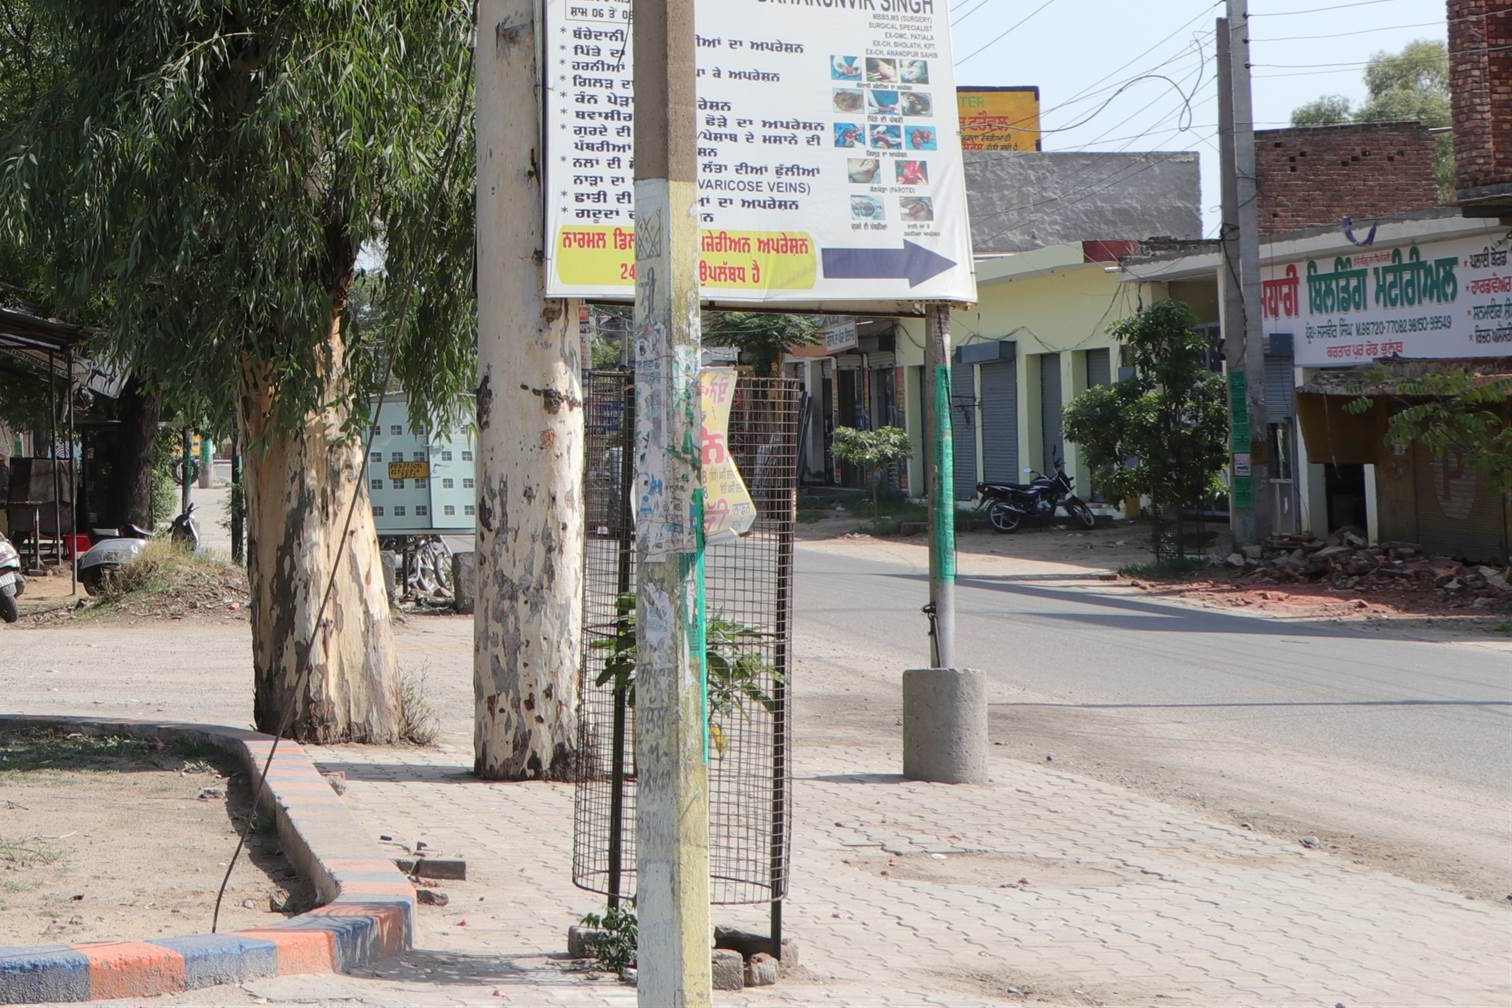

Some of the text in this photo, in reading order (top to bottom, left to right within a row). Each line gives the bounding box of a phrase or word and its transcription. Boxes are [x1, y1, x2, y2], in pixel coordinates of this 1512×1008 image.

[592, 8, 604, 18] 06
[728, 38, 743, 50] ਦਾ
[736, 118, 753, 128] ਦਾ
[616, 125, 631, 137] ਦੀ
[806, 134, 821, 147] ਦੀ
[607, 156, 621, 169] ਦੀ
[768, 181, 810, 195] VEINS)
[616, 190, 631, 204] ਦੀ
[718, 198, 733, 208] ਦਾ
[562, 232, 606, 249] ਨਾਰਮਲ
[752, 259, 760, 283] ਹੈ
